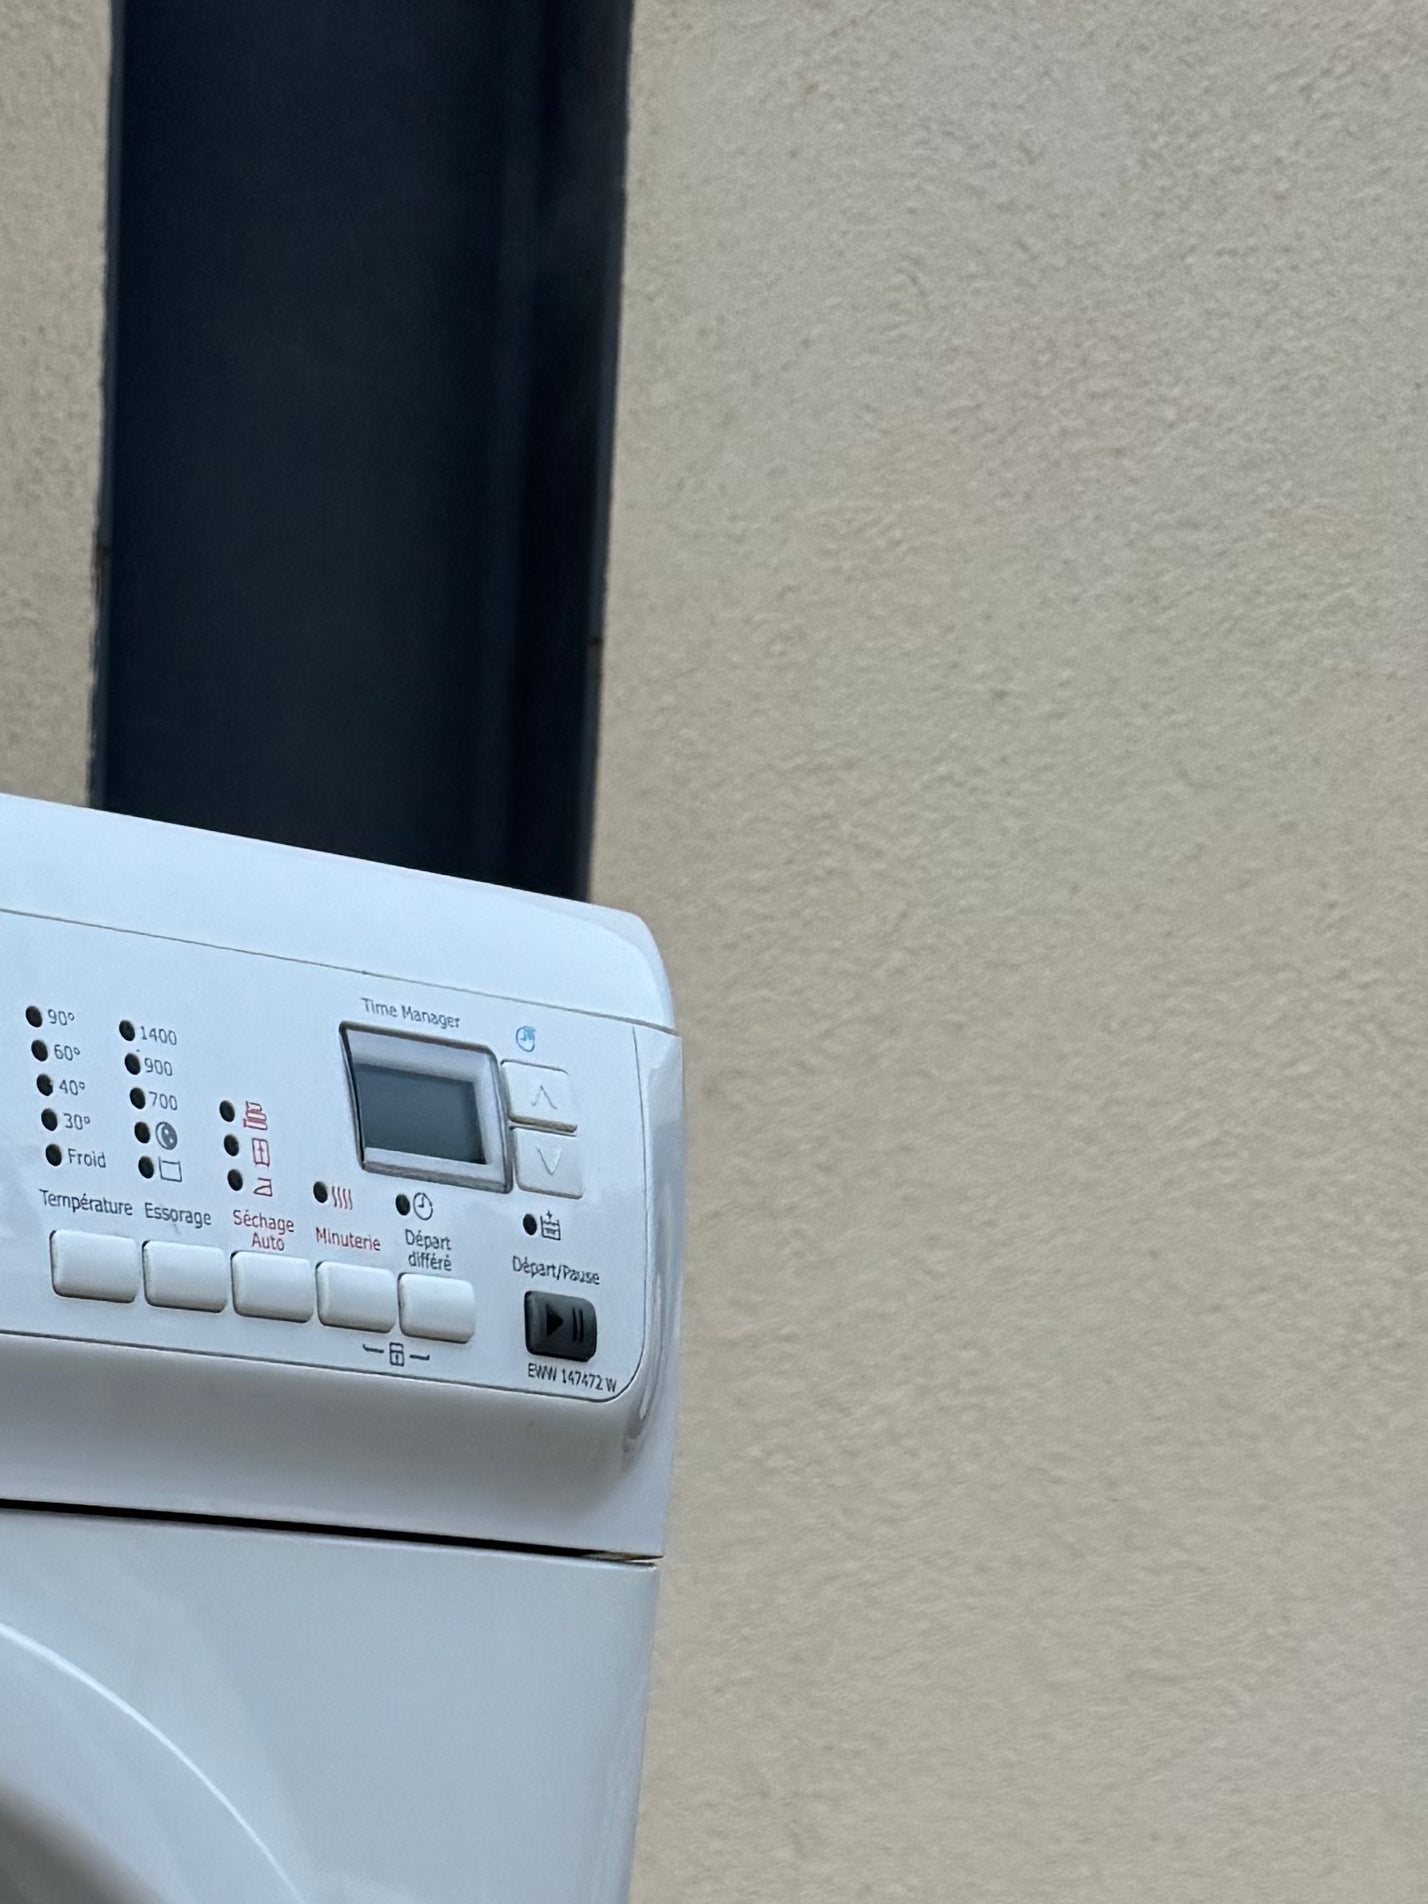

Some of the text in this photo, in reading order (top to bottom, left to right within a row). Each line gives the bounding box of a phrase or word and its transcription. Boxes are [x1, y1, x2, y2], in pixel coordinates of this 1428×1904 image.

[48, 1009, 75, 1026] 90°
[361, 997, 461, 1030] Time Manager
[140, 1026, 177, 1045] 1400
[54, 1045, 81, 1061] 60°
[144, 1058, 172, 1076] 900
[59, 1079, 85, 1096] 40°
[148, 1092, 177, 1110] 700
[63, 1113, 91, 1130] 30°
[68, 1148, 106, 1168] Froid
[39, 1188, 133, 1218] Température
[144, 1202, 212, 1229] Essorage
[233, 1210, 294, 1236] Séchage
[252, 1232, 285, 1252] Auto
[316, 1227, 381, 1252] Minuterie
[406, 1228, 451, 1252] Départ
[408, 1249, 452, 1273] différé
[512, 1255, 600, 1287] Départ/Pause
[562, 1368, 603, 1390] 147472
[606, 1378, 617, 1392] W
